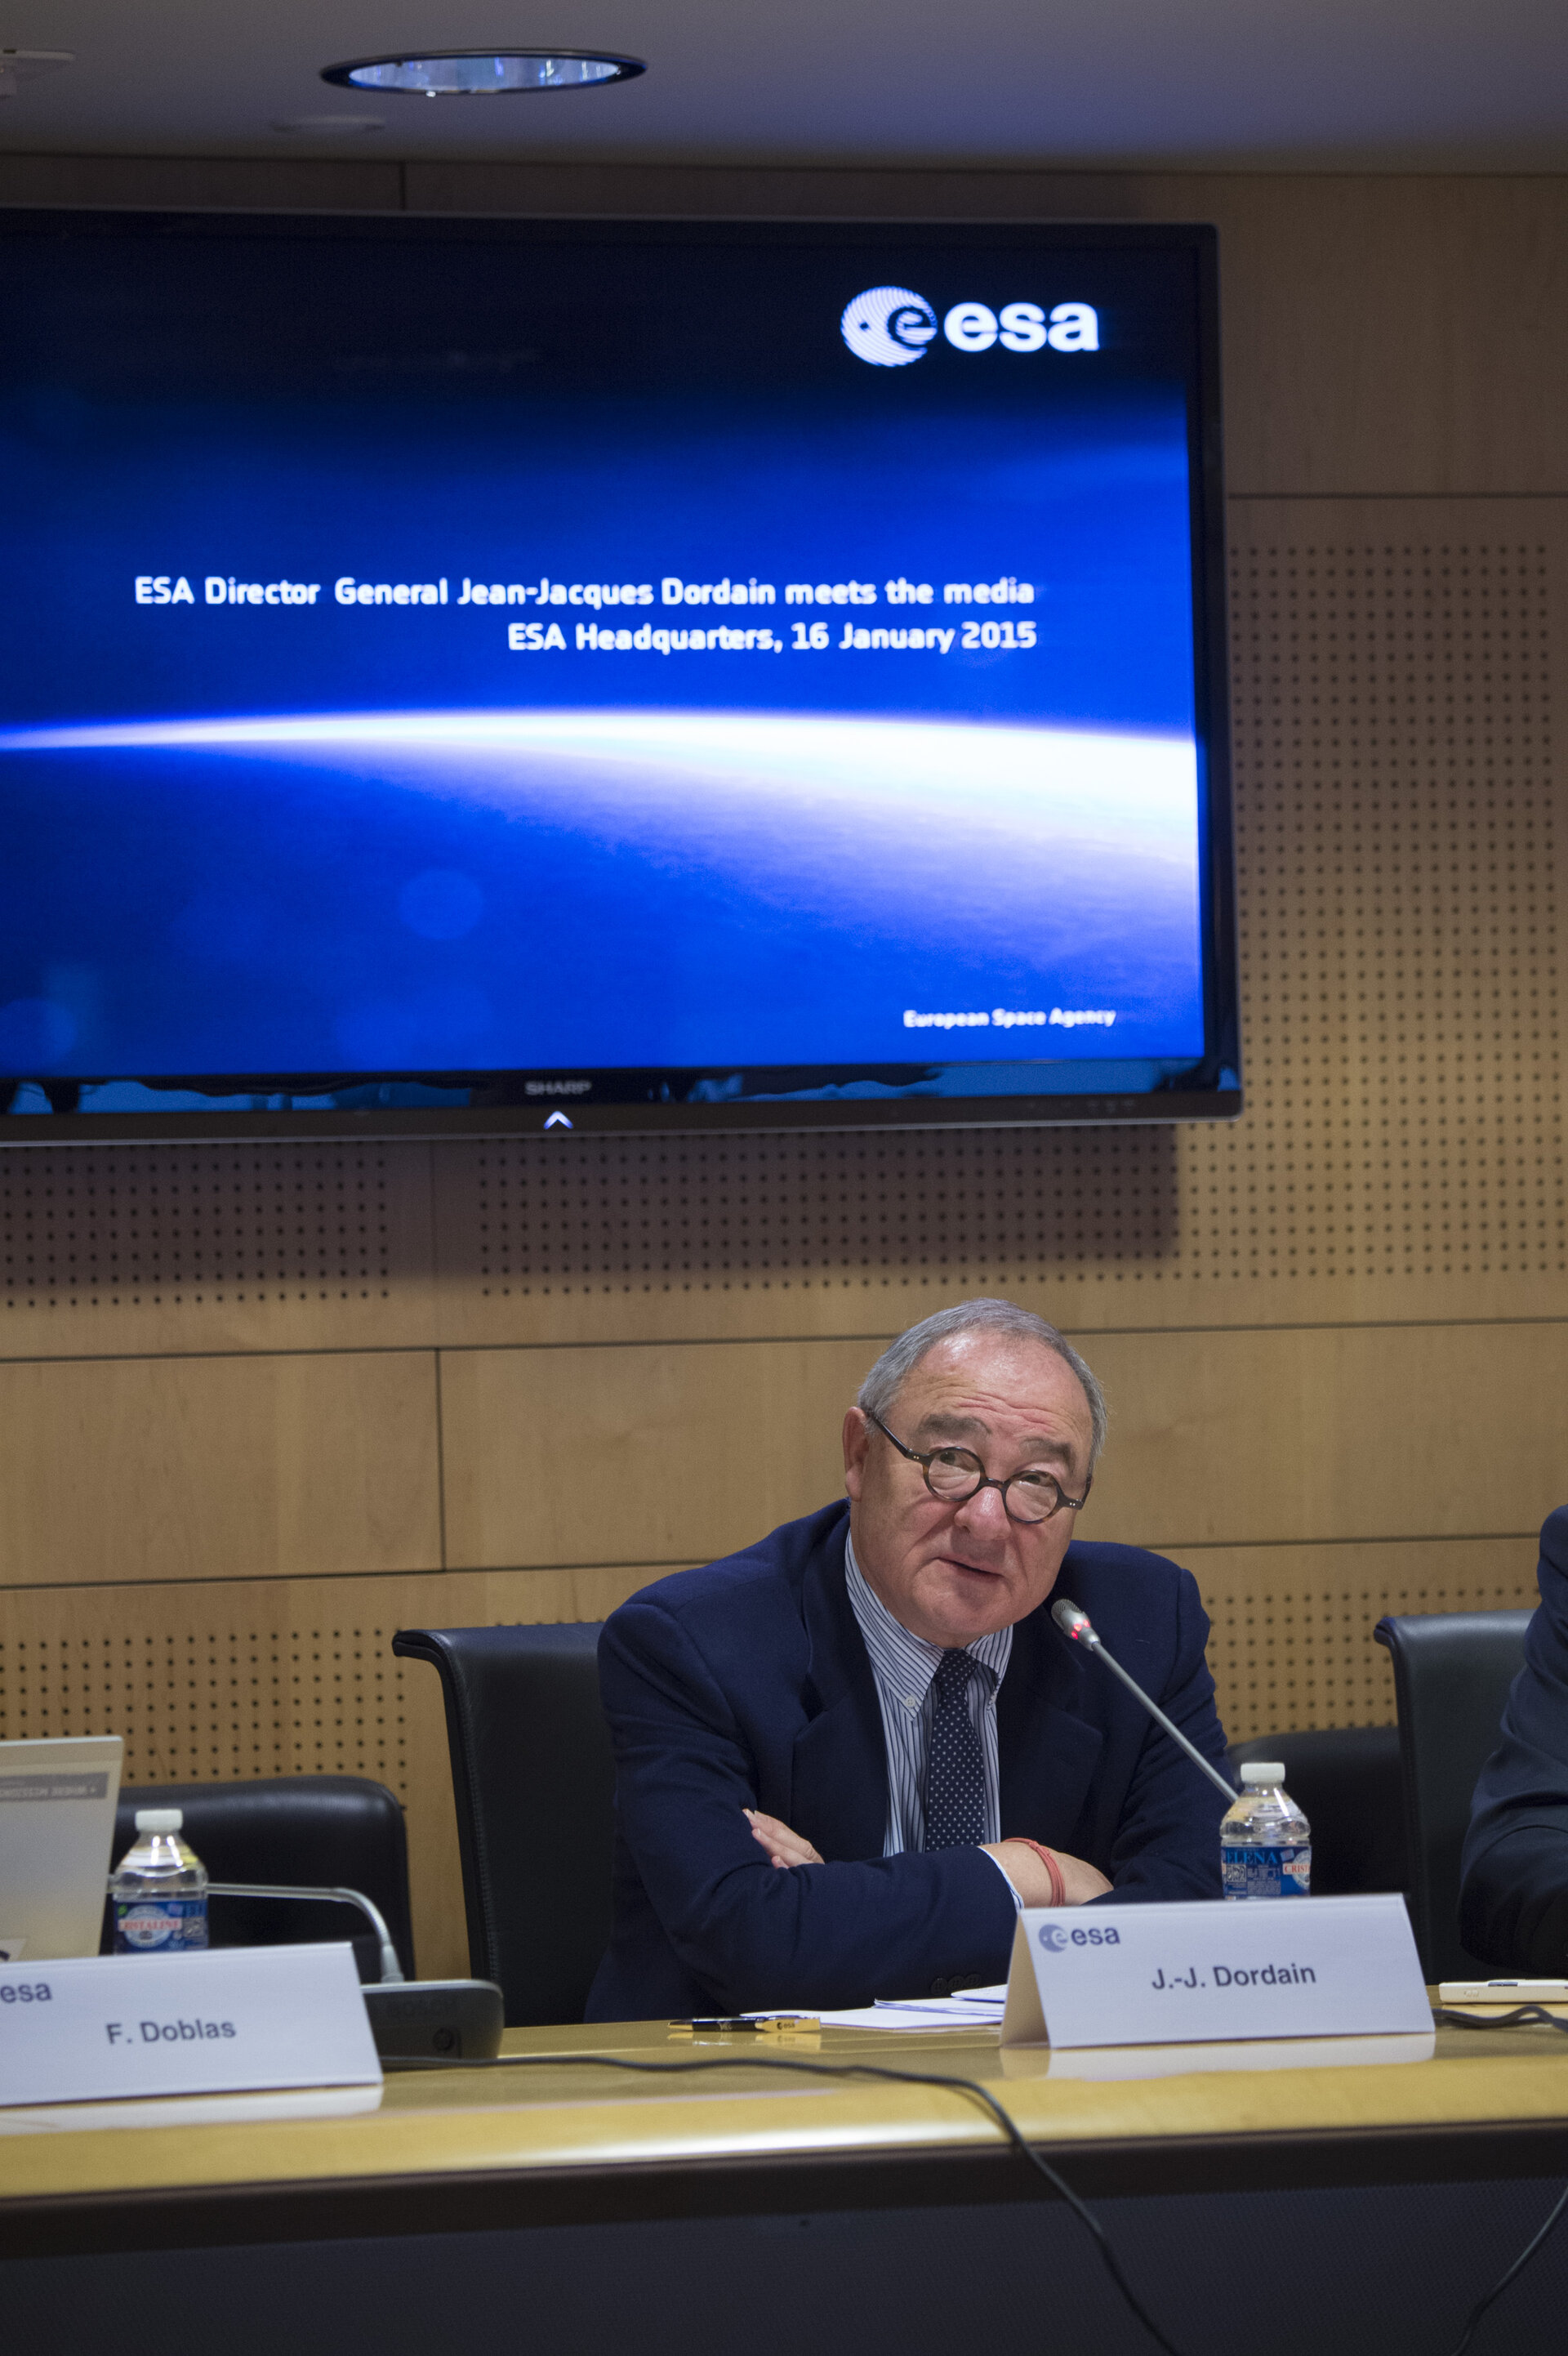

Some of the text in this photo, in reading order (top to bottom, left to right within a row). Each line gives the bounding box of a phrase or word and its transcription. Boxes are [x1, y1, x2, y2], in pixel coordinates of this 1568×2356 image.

[944, 302, 1100, 352] esa
[135, 576, 1035, 610] ESA Director General Jean-Jacques Dordain meets the media
[508, 620, 1037, 656] ESA Headquarters, 16 January 2015
[903, 1007, 1116, 1030] European Space Agency
[524, 1080, 592, 1095] SHARP
[1070, 1926, 1121, 1948] esa
[1152, 1962, 1317, 1990] J.-J. Dordain
[0, 1982, 52, 2004] esa
[105, 2018, 237, 2045] F. Doblas
